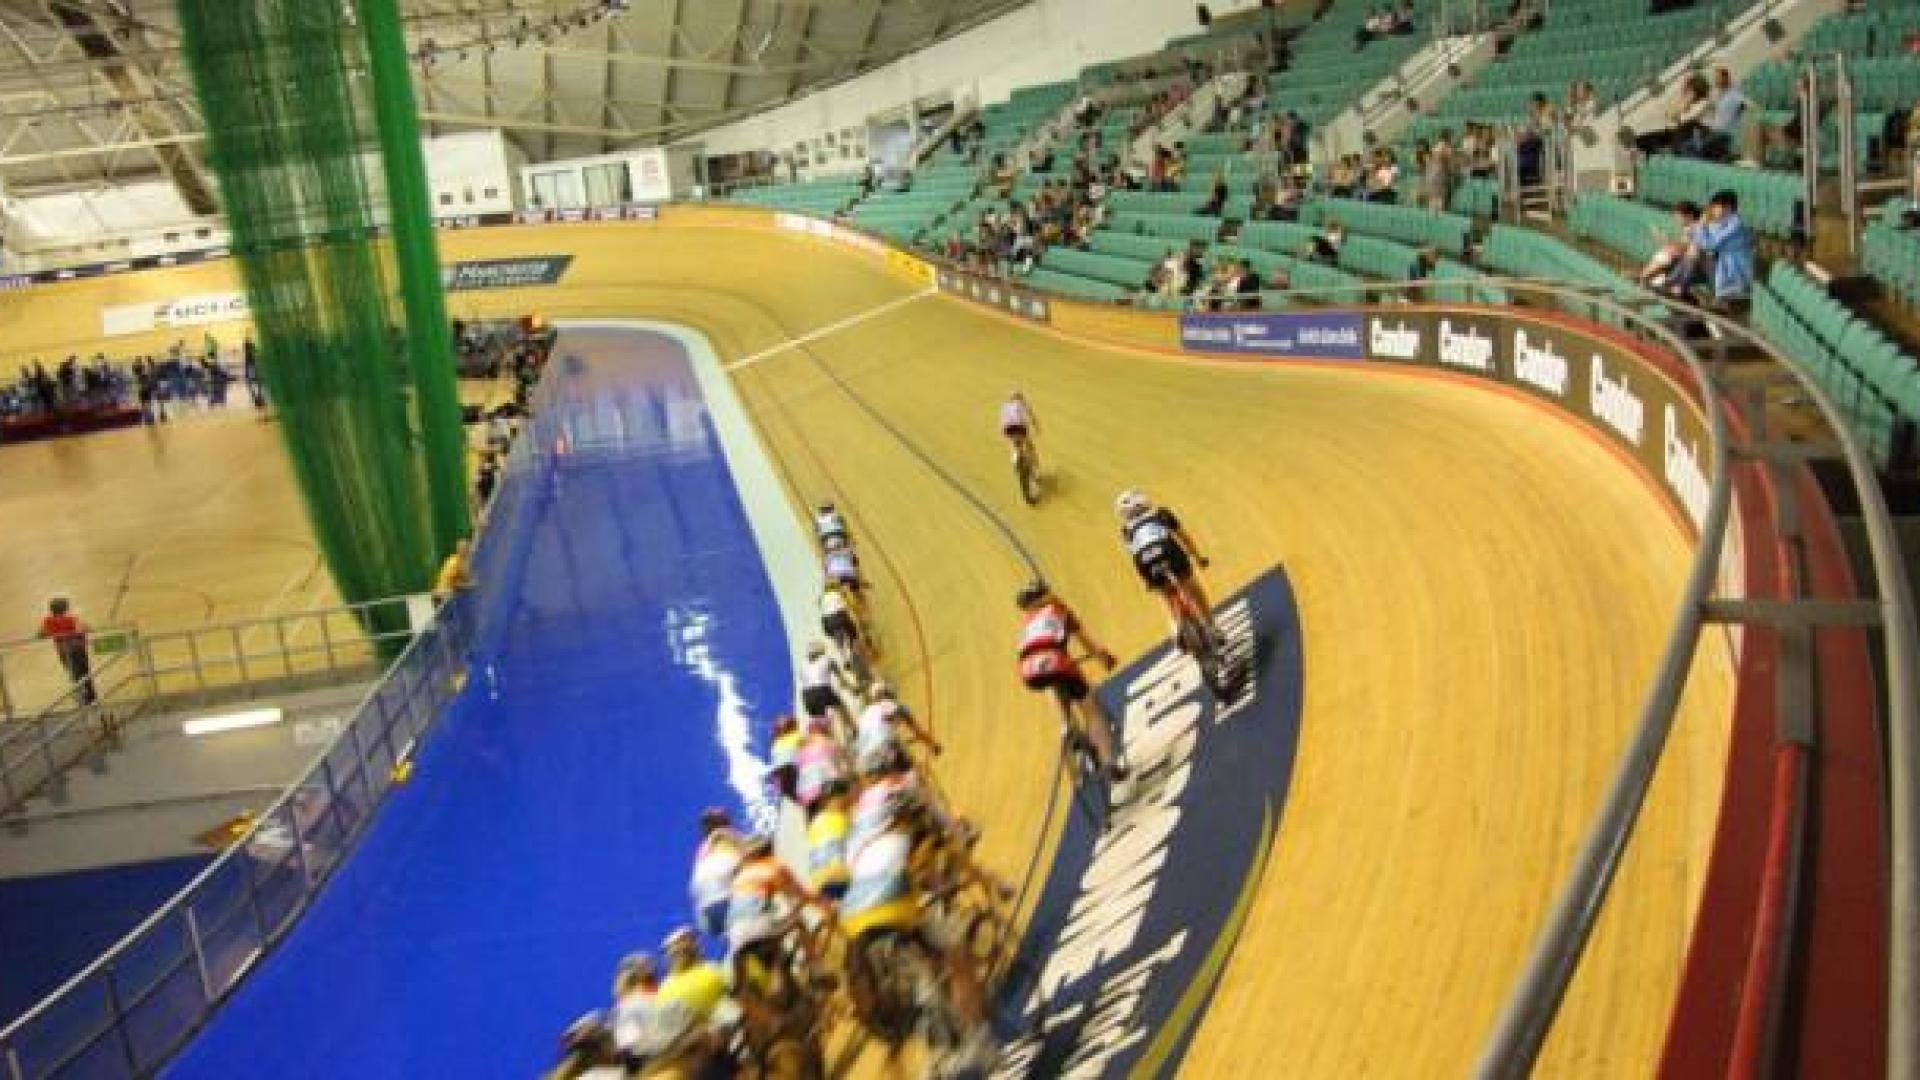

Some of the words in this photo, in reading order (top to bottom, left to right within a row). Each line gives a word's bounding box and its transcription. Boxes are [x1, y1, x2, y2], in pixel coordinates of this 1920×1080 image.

[1371, 317, 1420, 358] Condor
[1438, 319, 1493, 370] Condor
[1514, 328, 1568, 395] Condor
[1591, 352, 1644, 447] Condor
